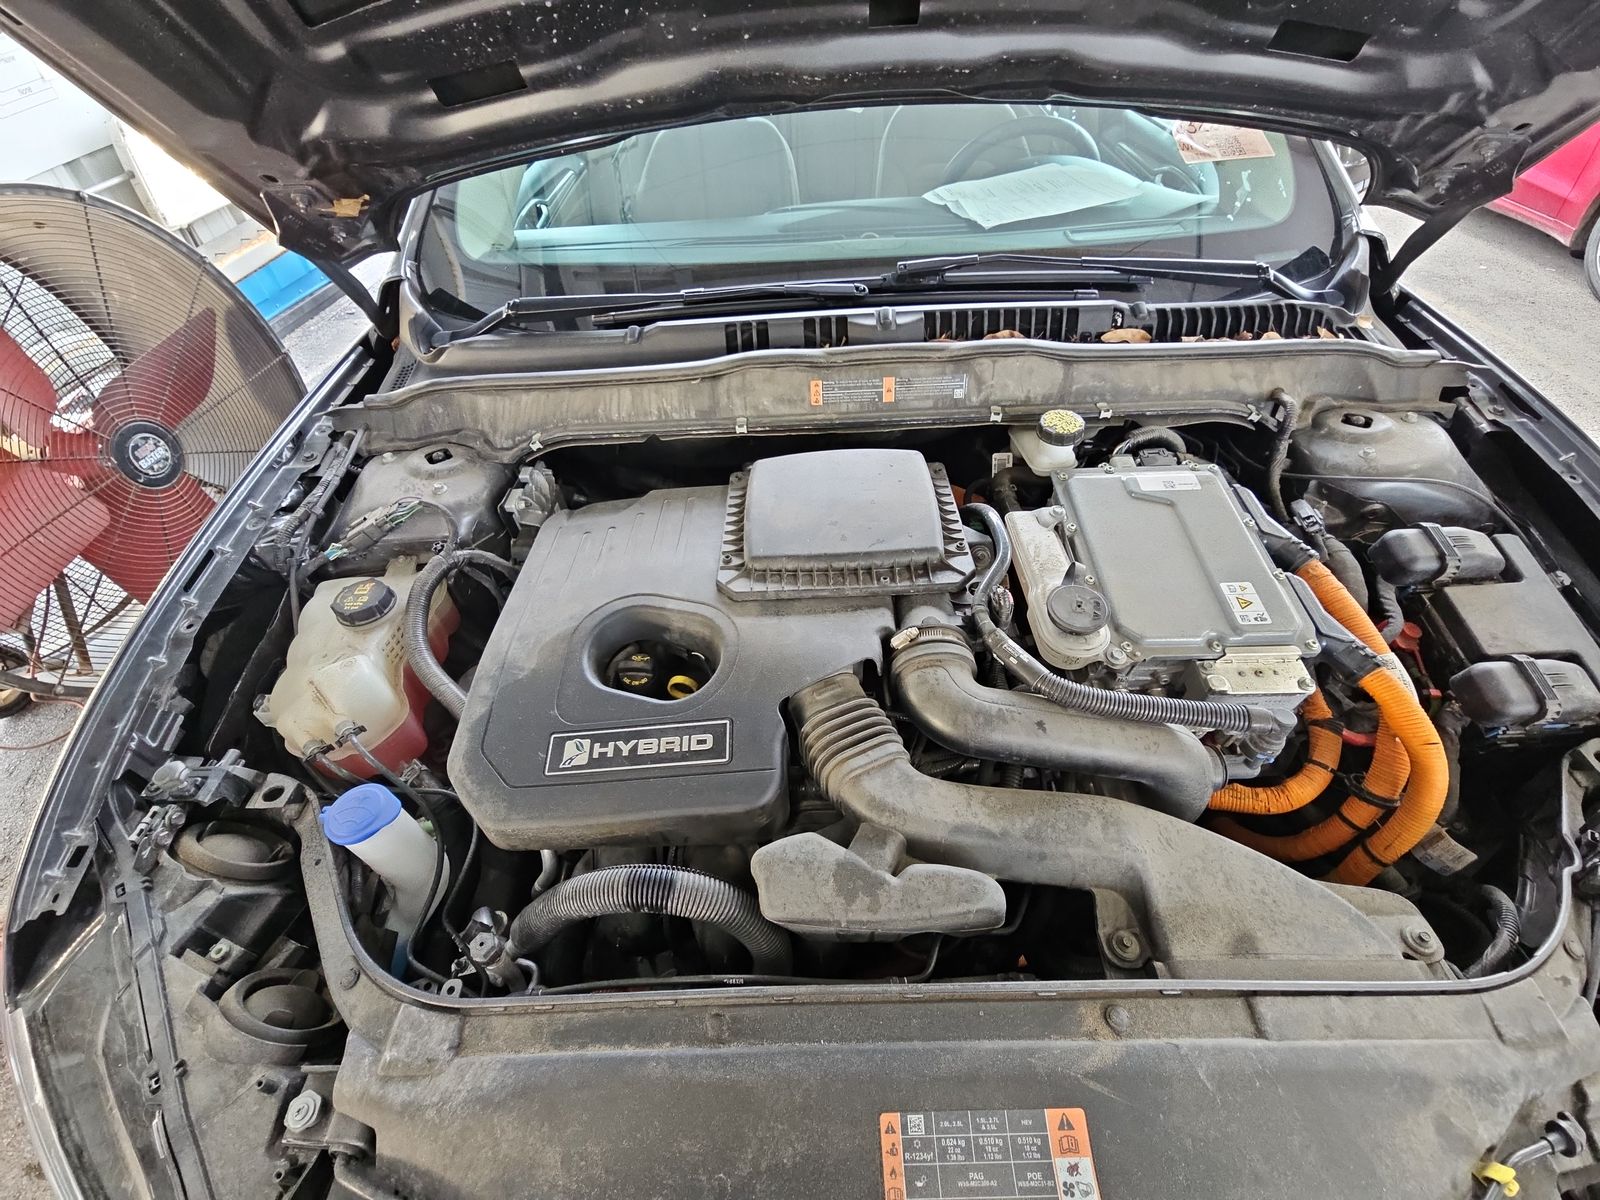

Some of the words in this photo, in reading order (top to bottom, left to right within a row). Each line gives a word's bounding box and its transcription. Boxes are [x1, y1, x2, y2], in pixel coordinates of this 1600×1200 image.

[592, 734, 713, 759] HYBRID
[941, 1138, 957, 1146] 0.624
[957, 1138, 966, 1148] kg
[978, 1137, 994, 1145] 0.510
[995, 1137, 1003, 1146] kg
[1017, 1136, 1033, 1144] 0.510
[1033, 1137, 1041, 1146] kg
[904, 1151, 934, 1162] R-1234yf
[968, 1172, 984, 1180] PAG
[1026, 1172, 1043, 1180] POE
